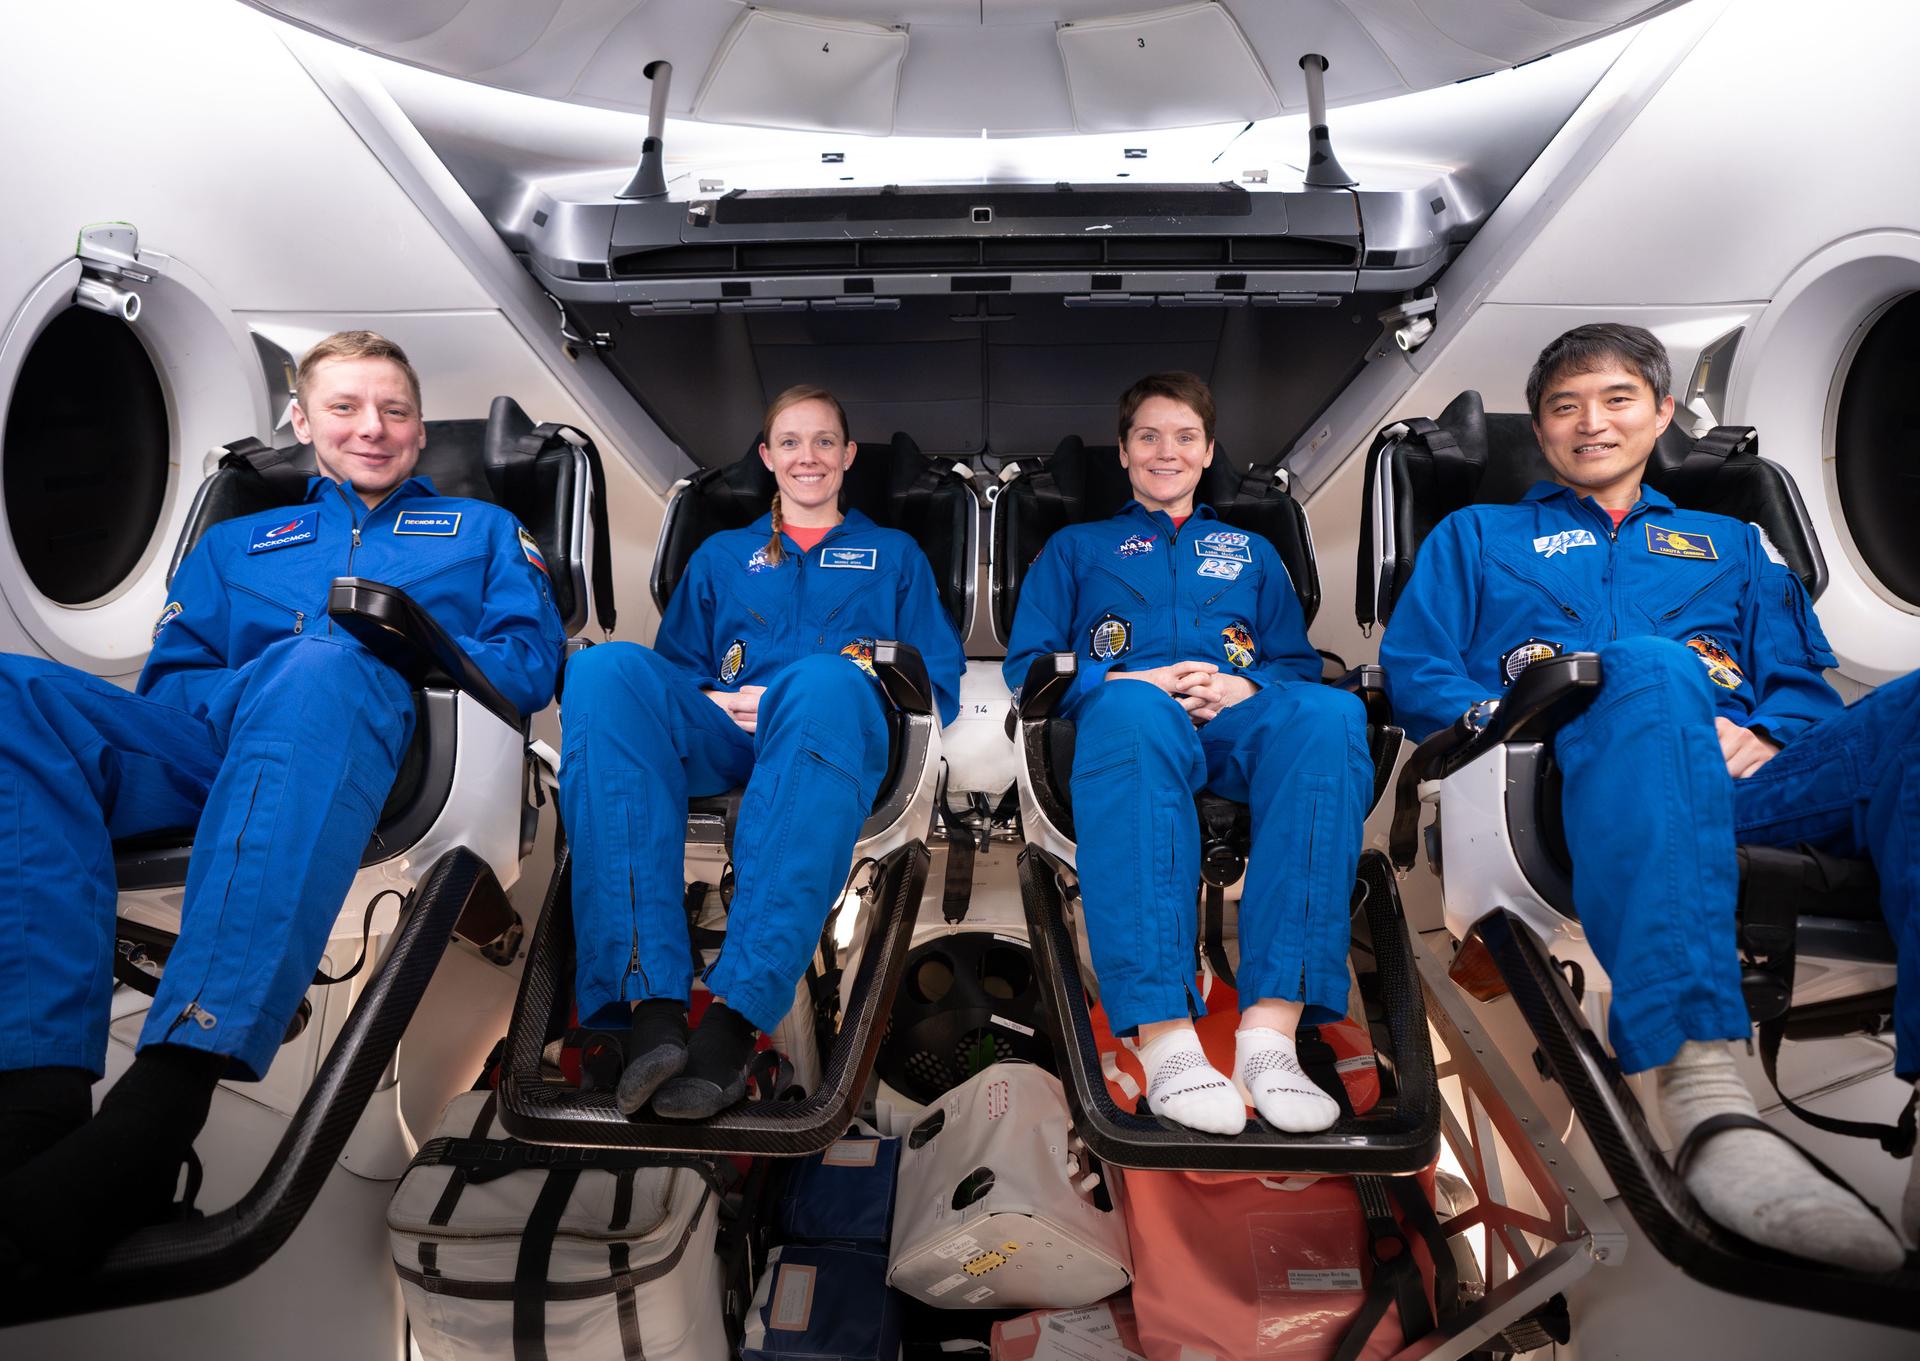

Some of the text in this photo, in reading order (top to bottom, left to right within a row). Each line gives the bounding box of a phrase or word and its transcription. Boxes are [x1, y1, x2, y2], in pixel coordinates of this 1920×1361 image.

[822, 42, 829, 53] 4
[1137, 38, 1145, 48] 3
[253, 532, 311, 549] РОСКОСМОС
[1120, 541, 1153, 552] NASA
[1538, 531, 1594, 558] JAXA
[975, 705, 988, 714] 14
[1160, 1081, 1227, 1104] BOMBAS
[1267, 1087, 1334, 1102] MBAS
